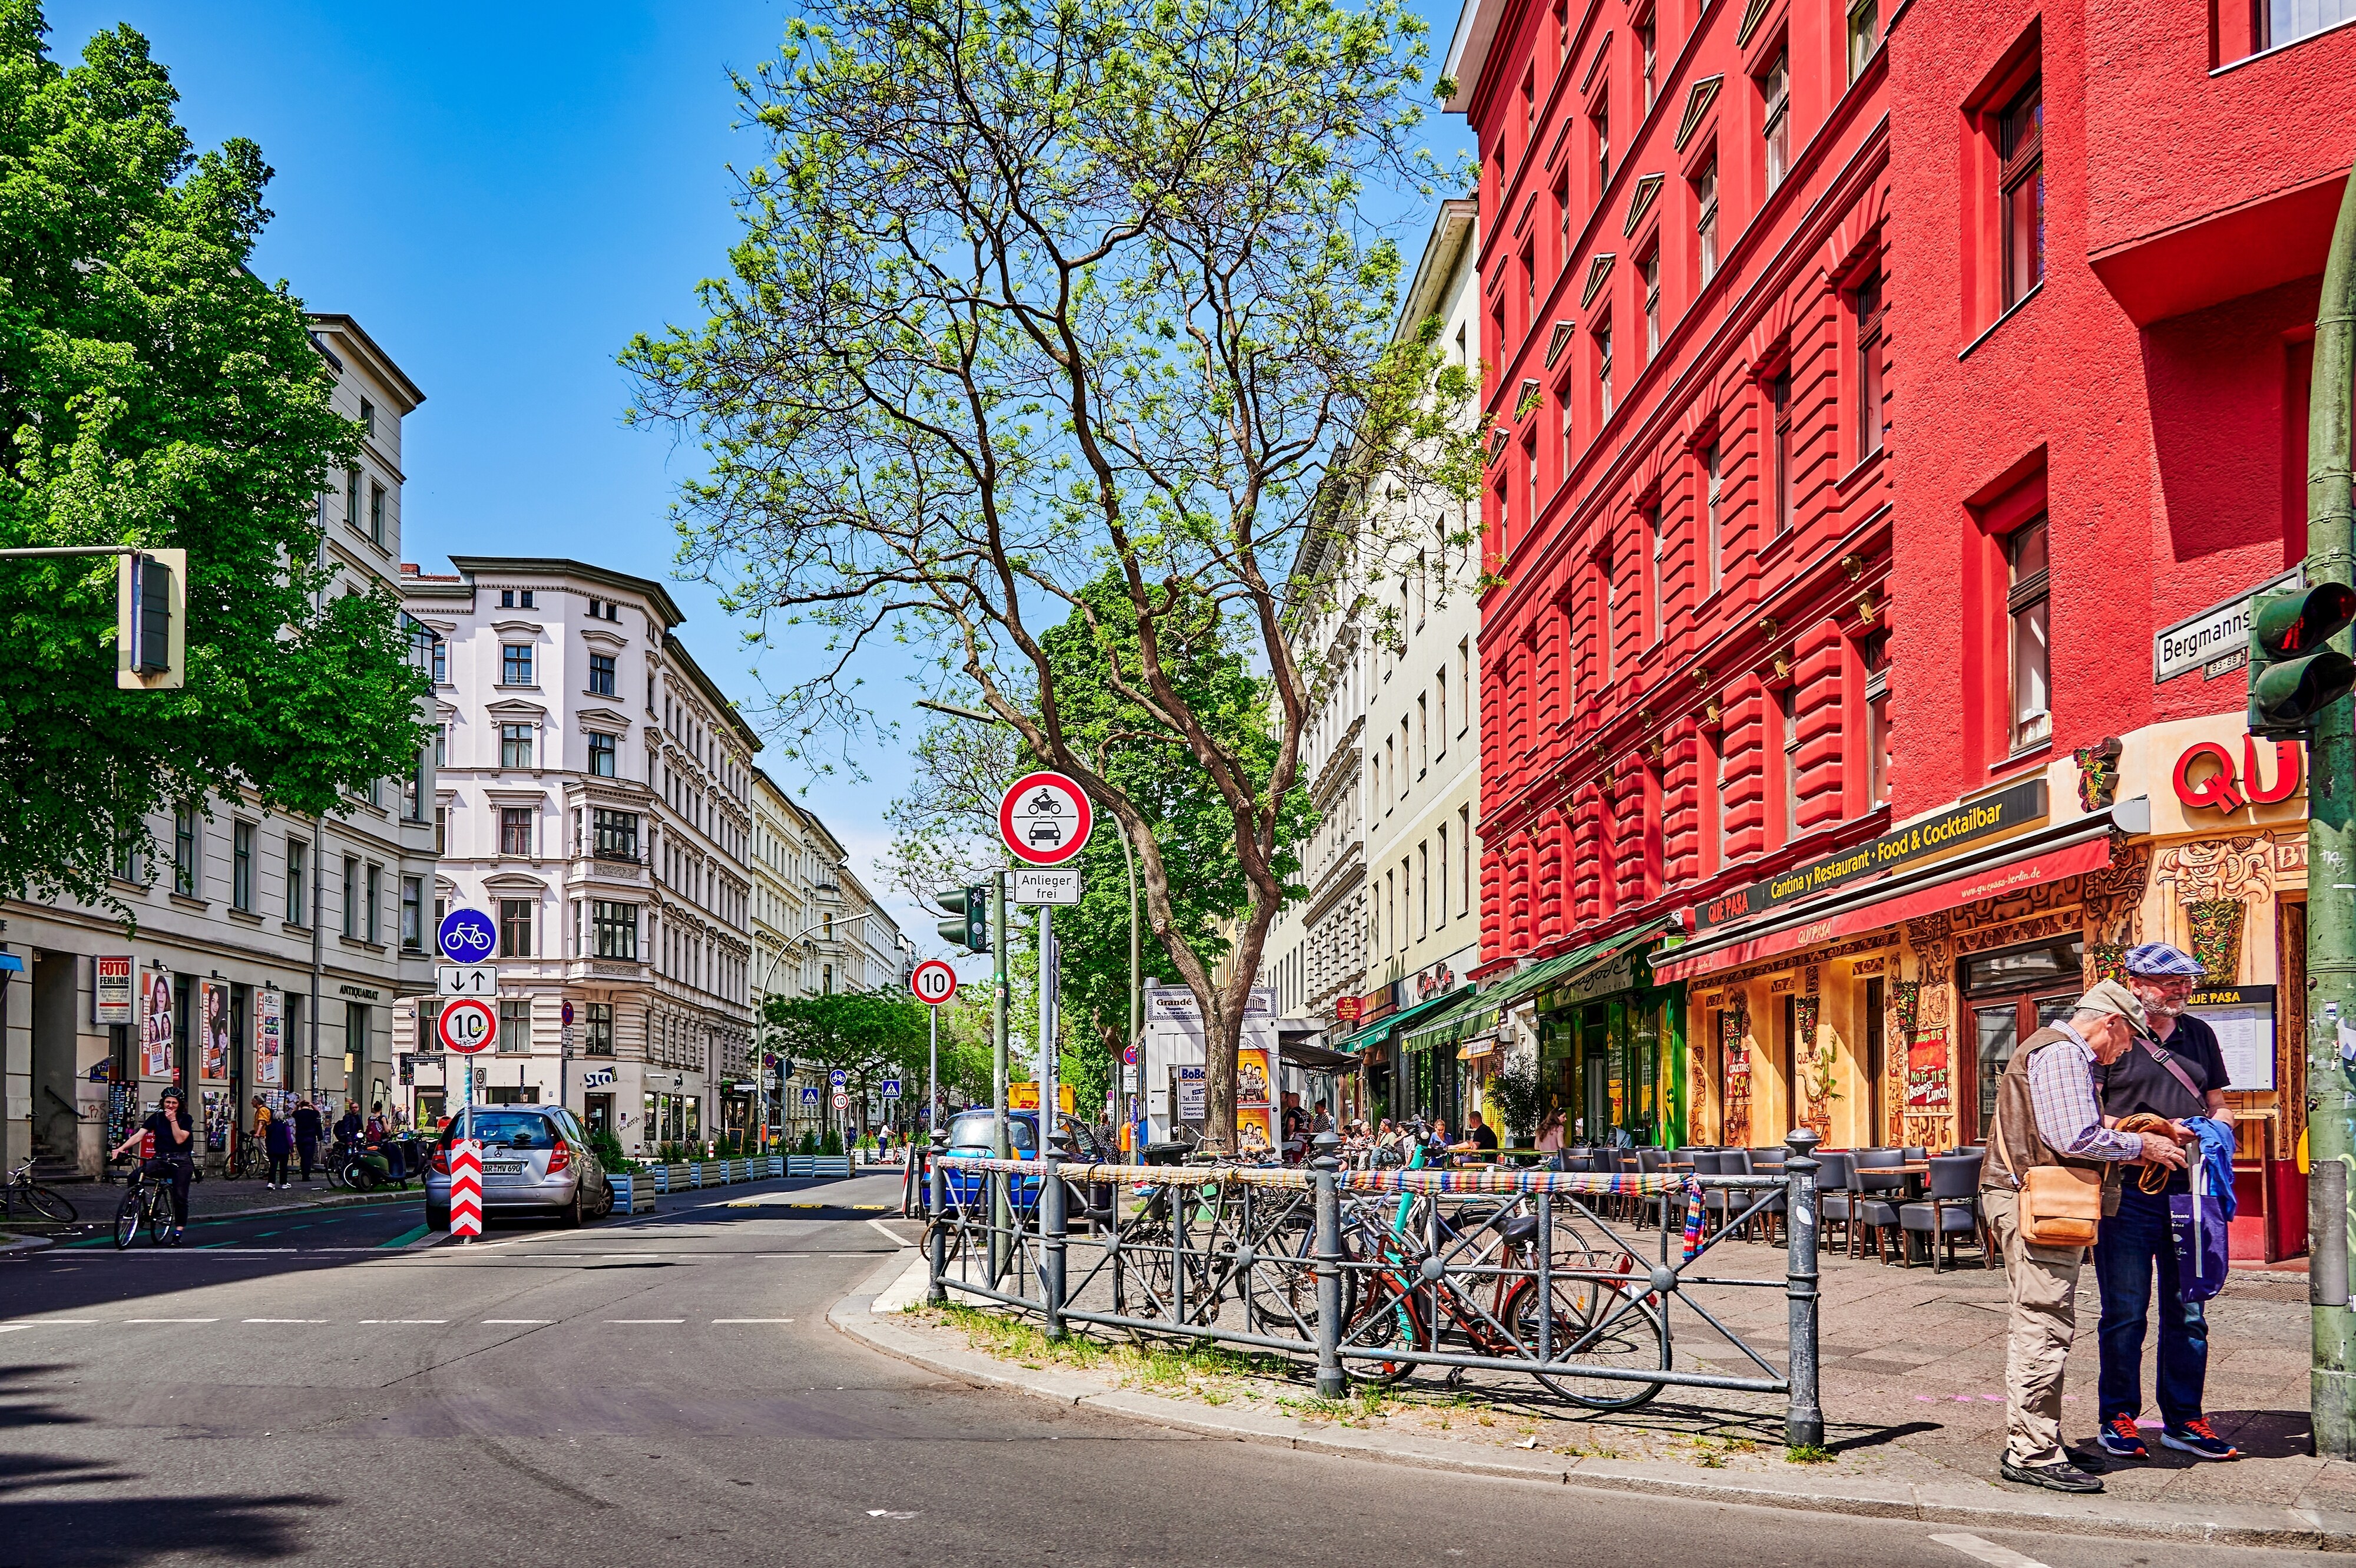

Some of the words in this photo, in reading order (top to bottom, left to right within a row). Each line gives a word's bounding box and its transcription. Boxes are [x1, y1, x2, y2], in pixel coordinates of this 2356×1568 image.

[2212, 655, 2237, 671] 93-88
[1708, 901, 1725, 924] QUE
[1725, 891, 1749, 919] PASA
[1771, 874, 1804, 899] Cantina
[1806, 874, 1813, 891] y
[1814, 851, 1870, 885] Restaurant
[1877, 835, 1908, 862] Food
[1911, 829, 1921, 851] &
[1922, 801, 2003, 846] Cocktailbar
[1021, 875, 1071, 888] Anlieger
[1037, 888, 1057, 898] frei
[99, 961, 130, 976] FOTO
[924, 974, 945, 993] 10
[1595, 981, 1627, 994] KITCHEN
[339, 984, 379, 1000] ANTIQUARIAT
[2187, 993, 2208, 1004] QUE
[2210, 991, 2241, 1003] PASA
[1156, 998, 1192, 1006] Grandé
[454, 1014, 482, 1038] 10
[151, 1045, 162, 1056] FOTO
[1729, 1063, 1750, 1074] COCKTAILS
[586, 1071, 613, 1086] sta
[1908, 1080, 1933, 1100] Business
[1926, 1083, 1947, 1104] Lunch
